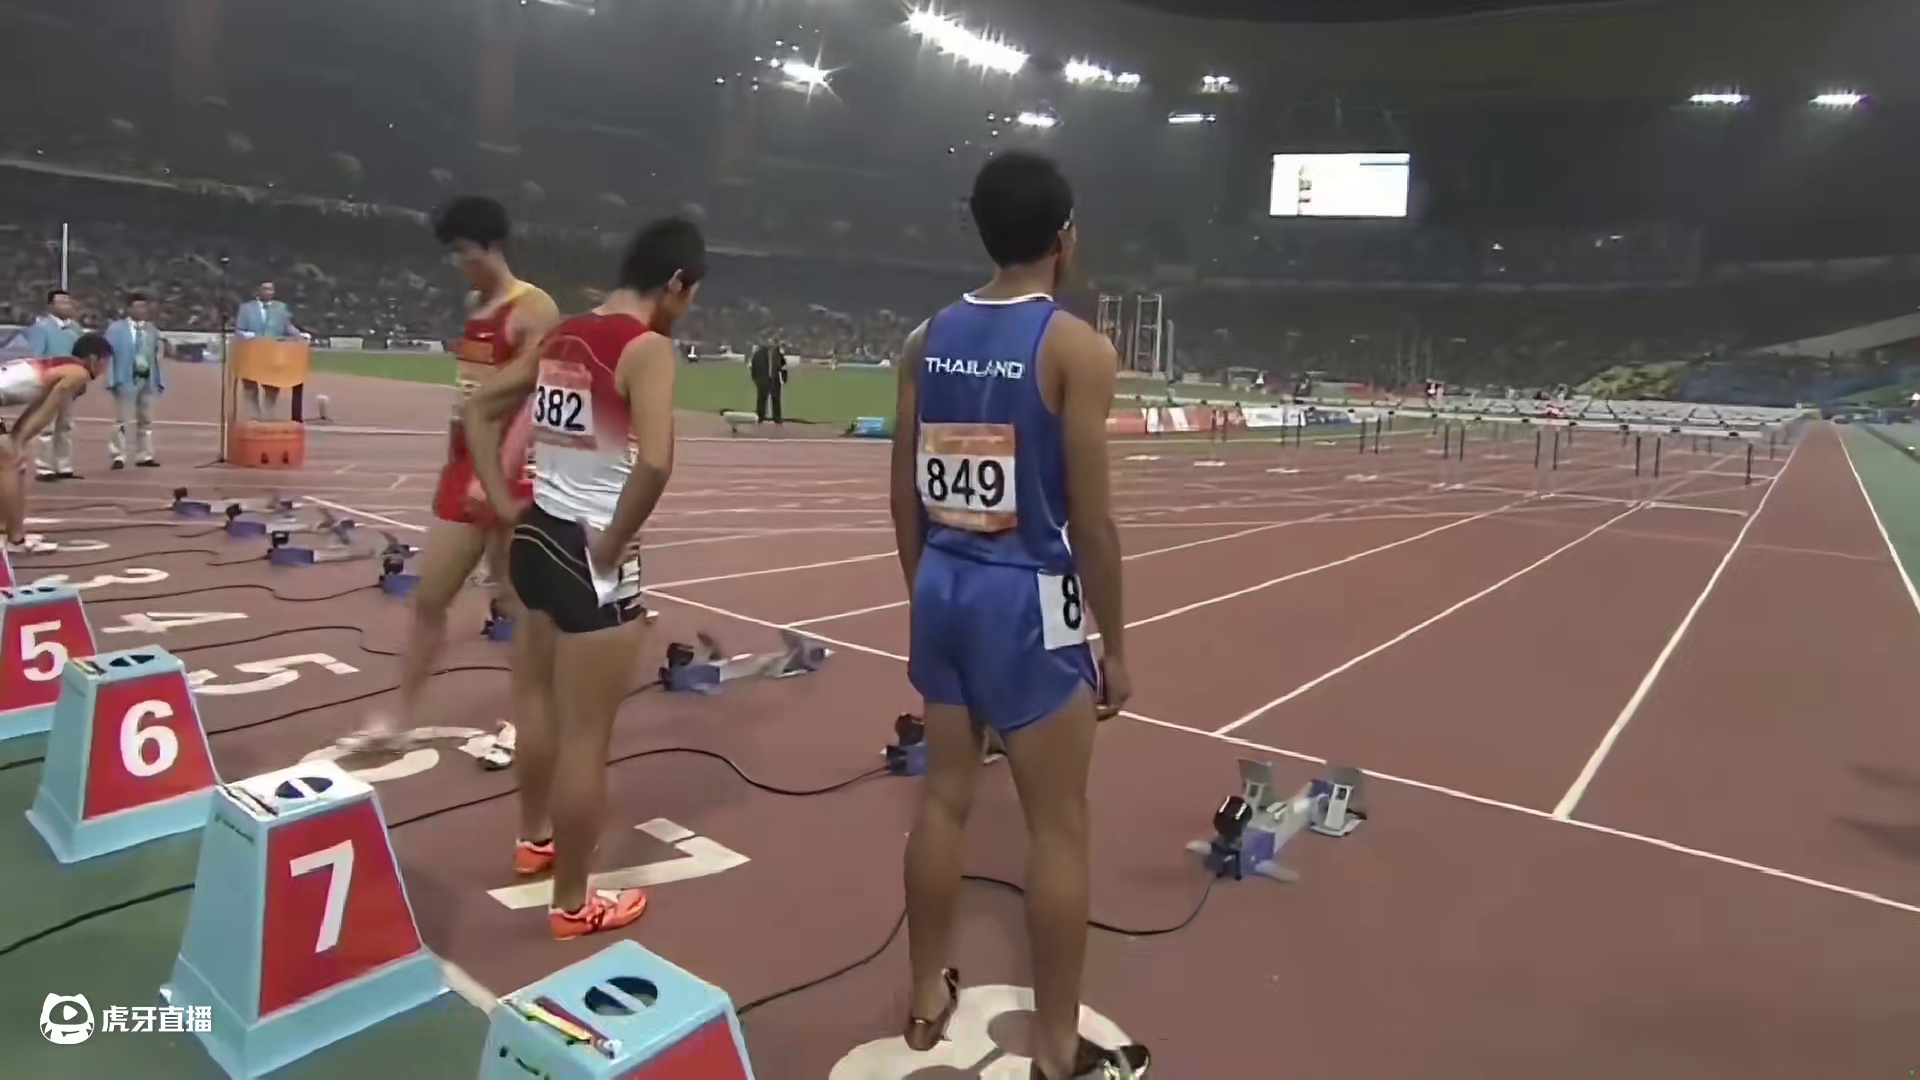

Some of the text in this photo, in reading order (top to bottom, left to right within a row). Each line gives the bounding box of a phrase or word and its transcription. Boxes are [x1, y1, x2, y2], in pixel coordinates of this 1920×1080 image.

[925, 356, 1025, 380] THAILAND
[534, 385, 586, 432] 382
[927, 457, 1006, 508] 849
[101, 611, 249, 633] 4
[1062, 574, 1083, 630] 8
[20, 619, 68, 682] 5
[187, 653, 360, 695] 5
[119, 699, 179, 777] 6
[486, 817, 752, 910] 7
[289, 839, 355, 954] 7
